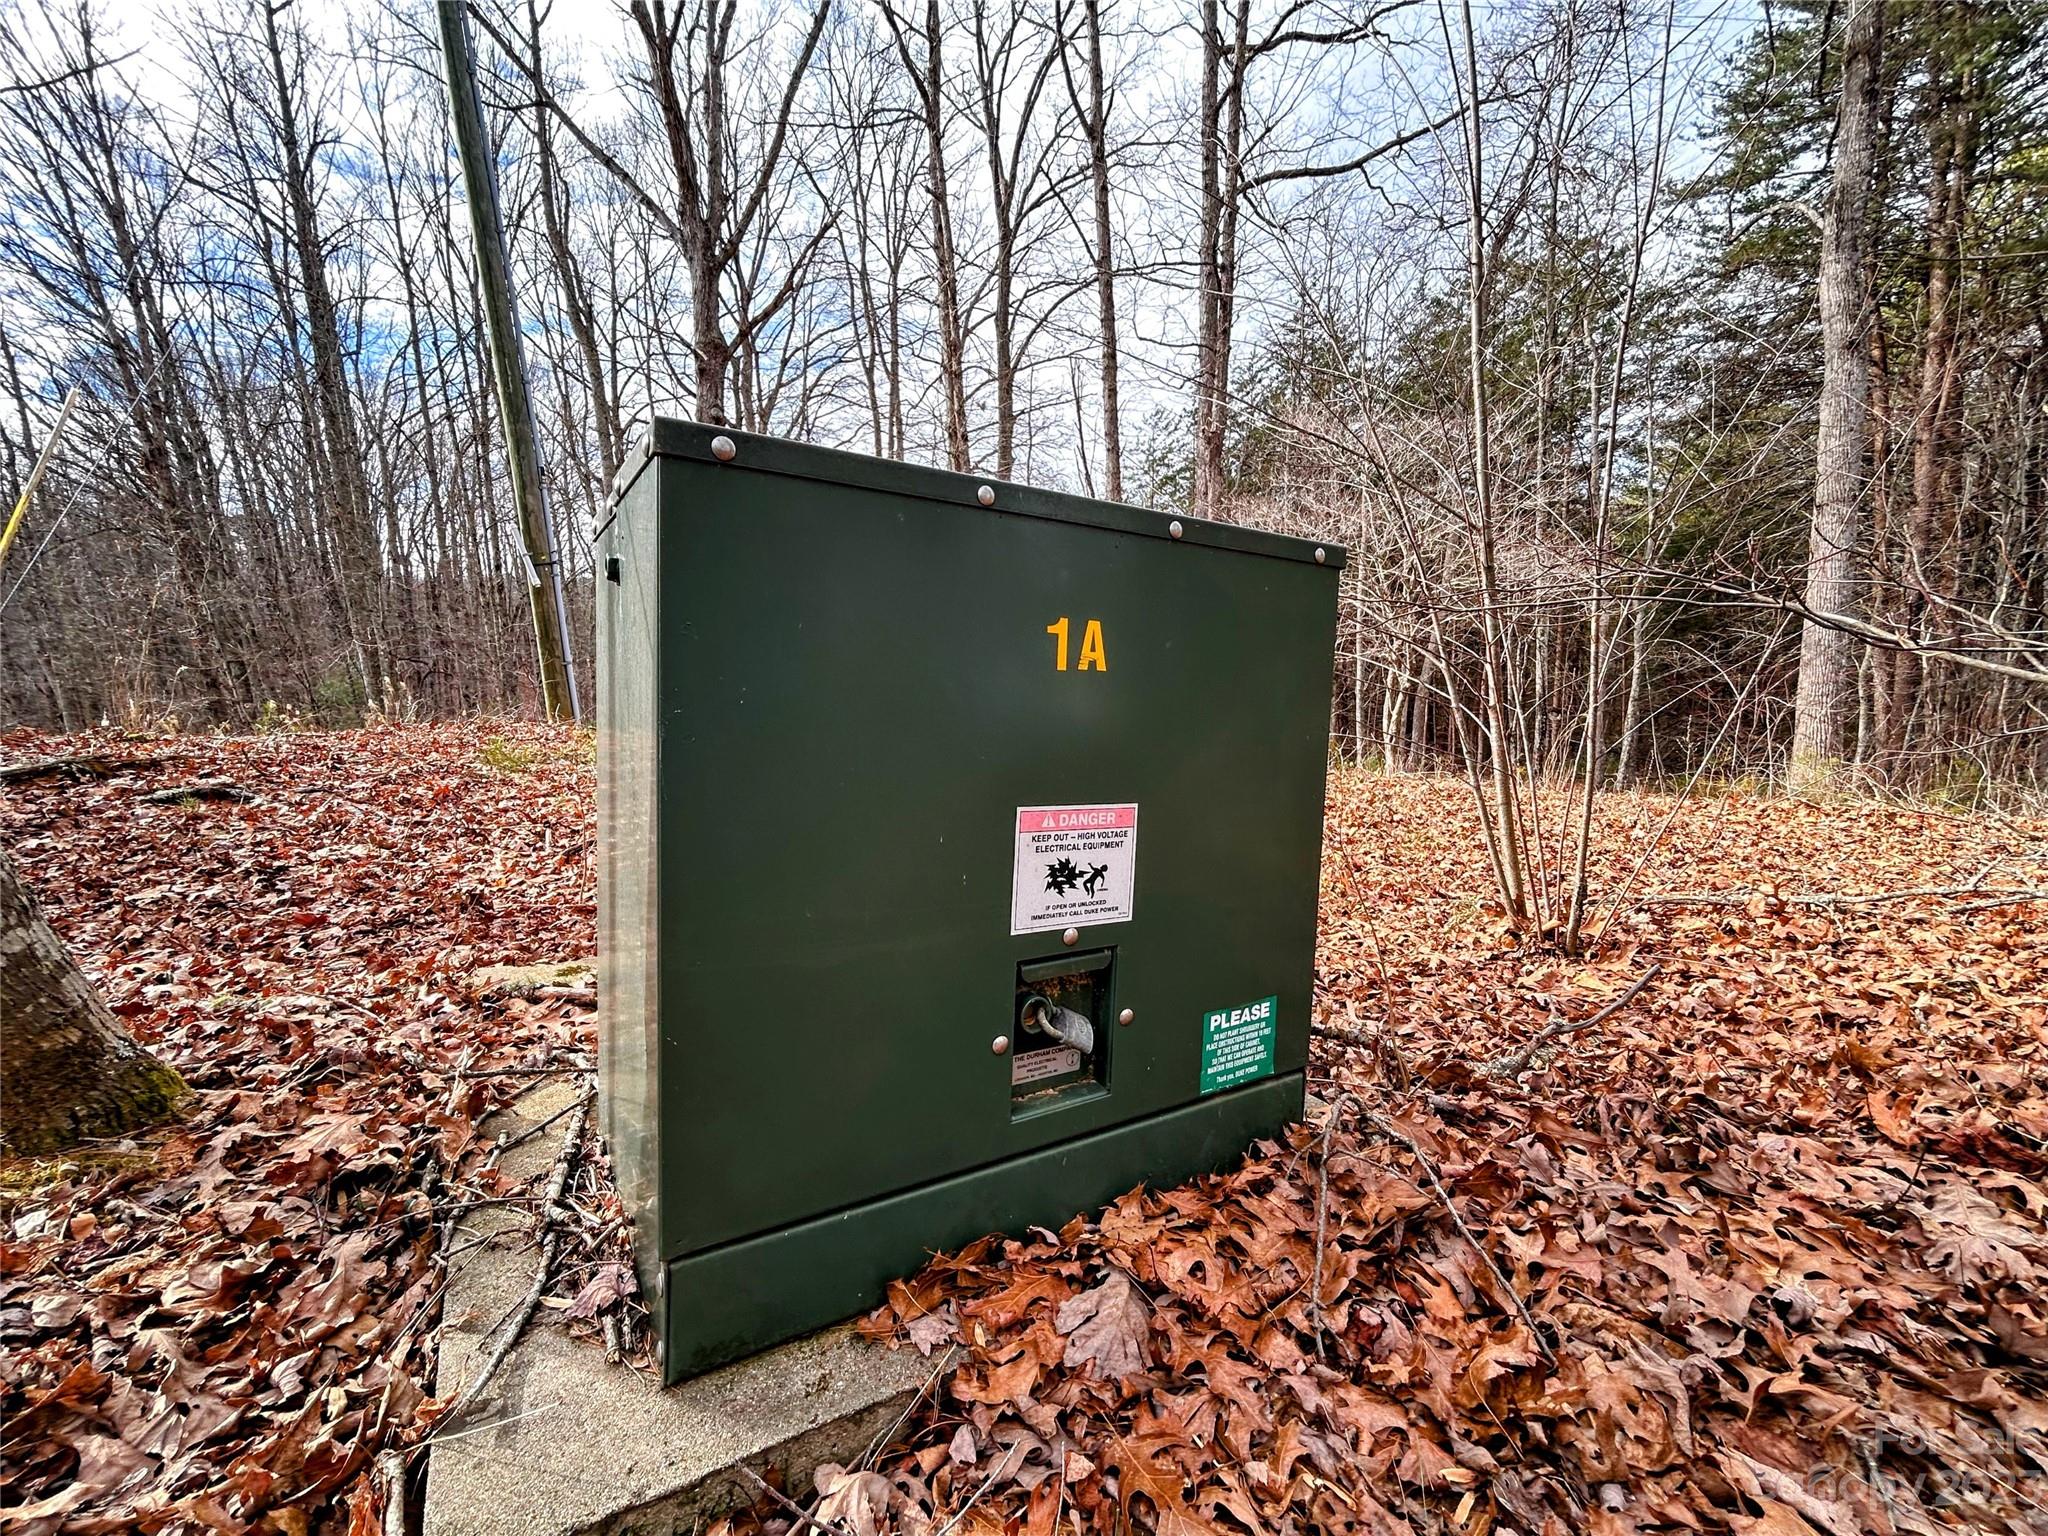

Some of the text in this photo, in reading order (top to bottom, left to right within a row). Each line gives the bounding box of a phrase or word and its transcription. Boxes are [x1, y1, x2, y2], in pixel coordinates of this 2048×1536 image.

[1047, 618, 1106, 671] 1A
[1059, 812, 1116, 826] DANGER
[1078, 832, 1095, 840] HIGH
[1097, 830, 1128, 838] VOLTAGE
[1036, 841, 1124, 853] ELECTRICAL EQUIPMENT
[1031, 912, 1068, 920] IMMEDIATELY
[1210, 1002, 1270, 1031] PLEASE
[1228, 1028, 1239, 1037] PLANT
[1206, 1042, 1218, 1051] PLACE
[1027, 1050, 1051, 1060] DURHAM
[1218, 1055, 1226, 1064] THAT
[1217, 1074, 1226, 1083] Thank
[1245, 1065, 1258, 1074] POWER
